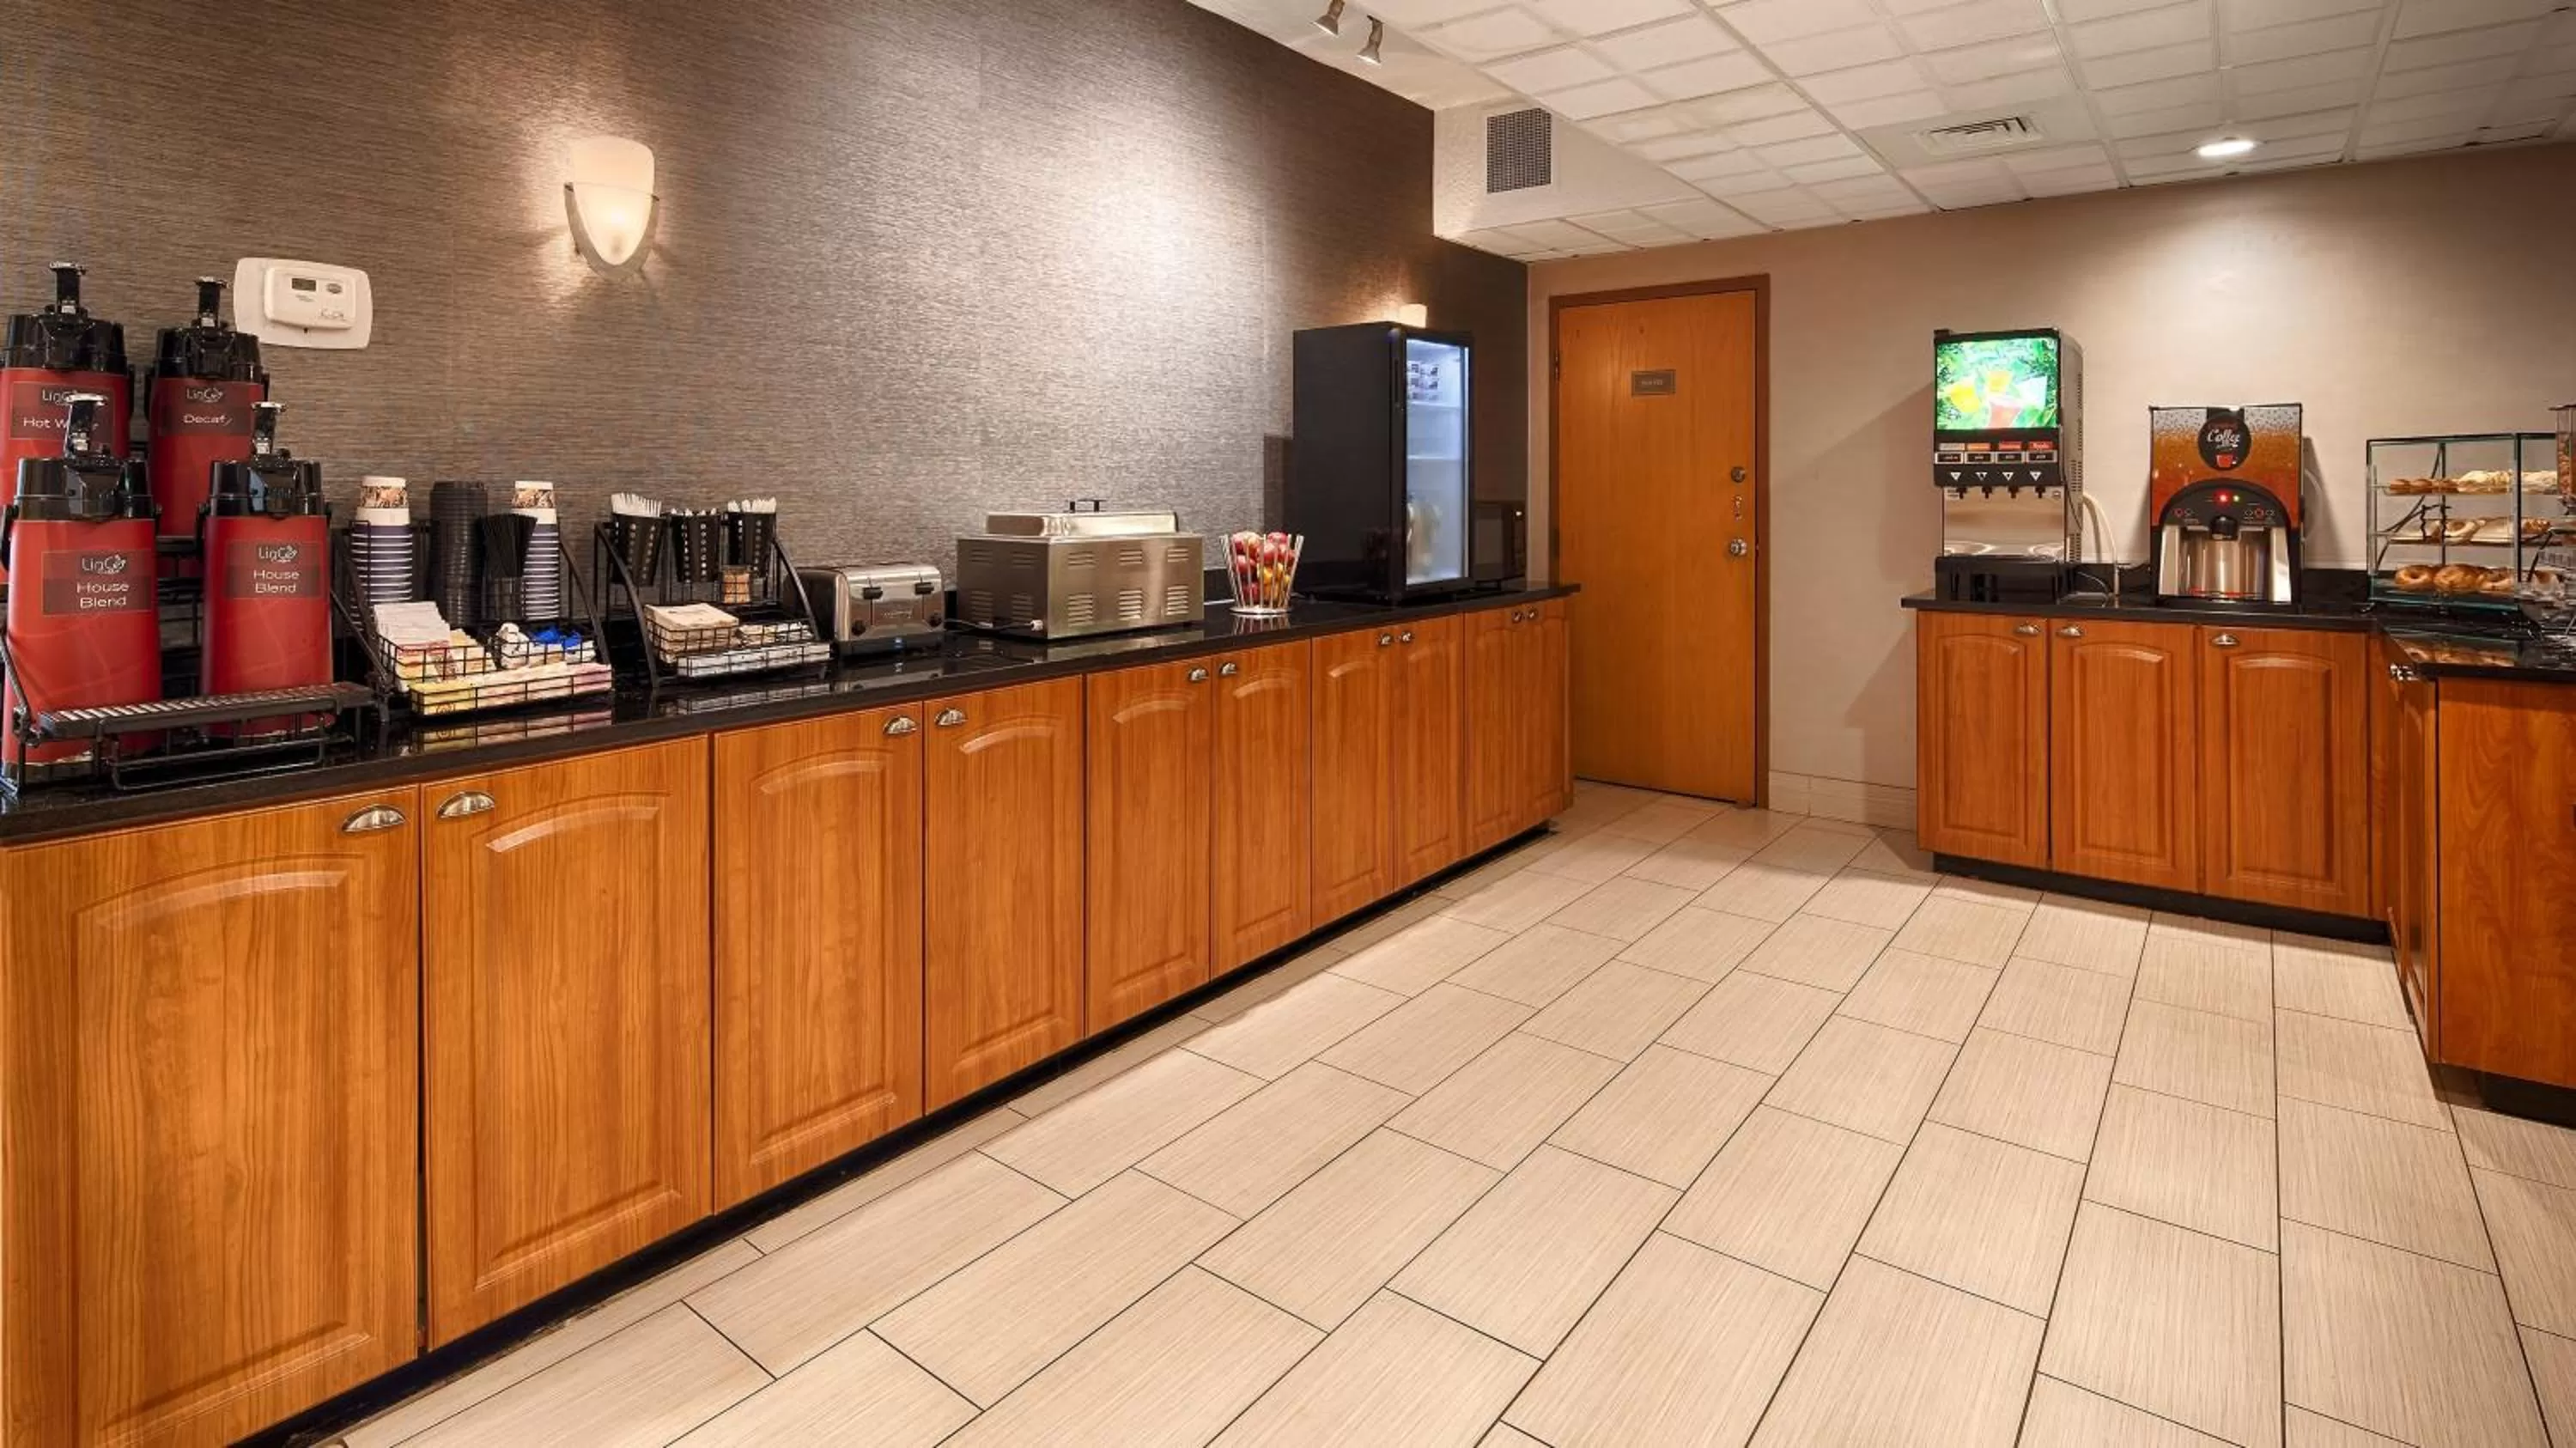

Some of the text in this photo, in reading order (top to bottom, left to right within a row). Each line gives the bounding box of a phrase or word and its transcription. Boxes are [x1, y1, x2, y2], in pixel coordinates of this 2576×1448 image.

[23, 417, 51, 429] Hot
[184, 413, 226, 424] Decaf
[253, 569, 300, 580] House
[76, 581, 130, 593] House
[255, 582, 296, 593] Blend
[80, 596, 126, 609] Blend
